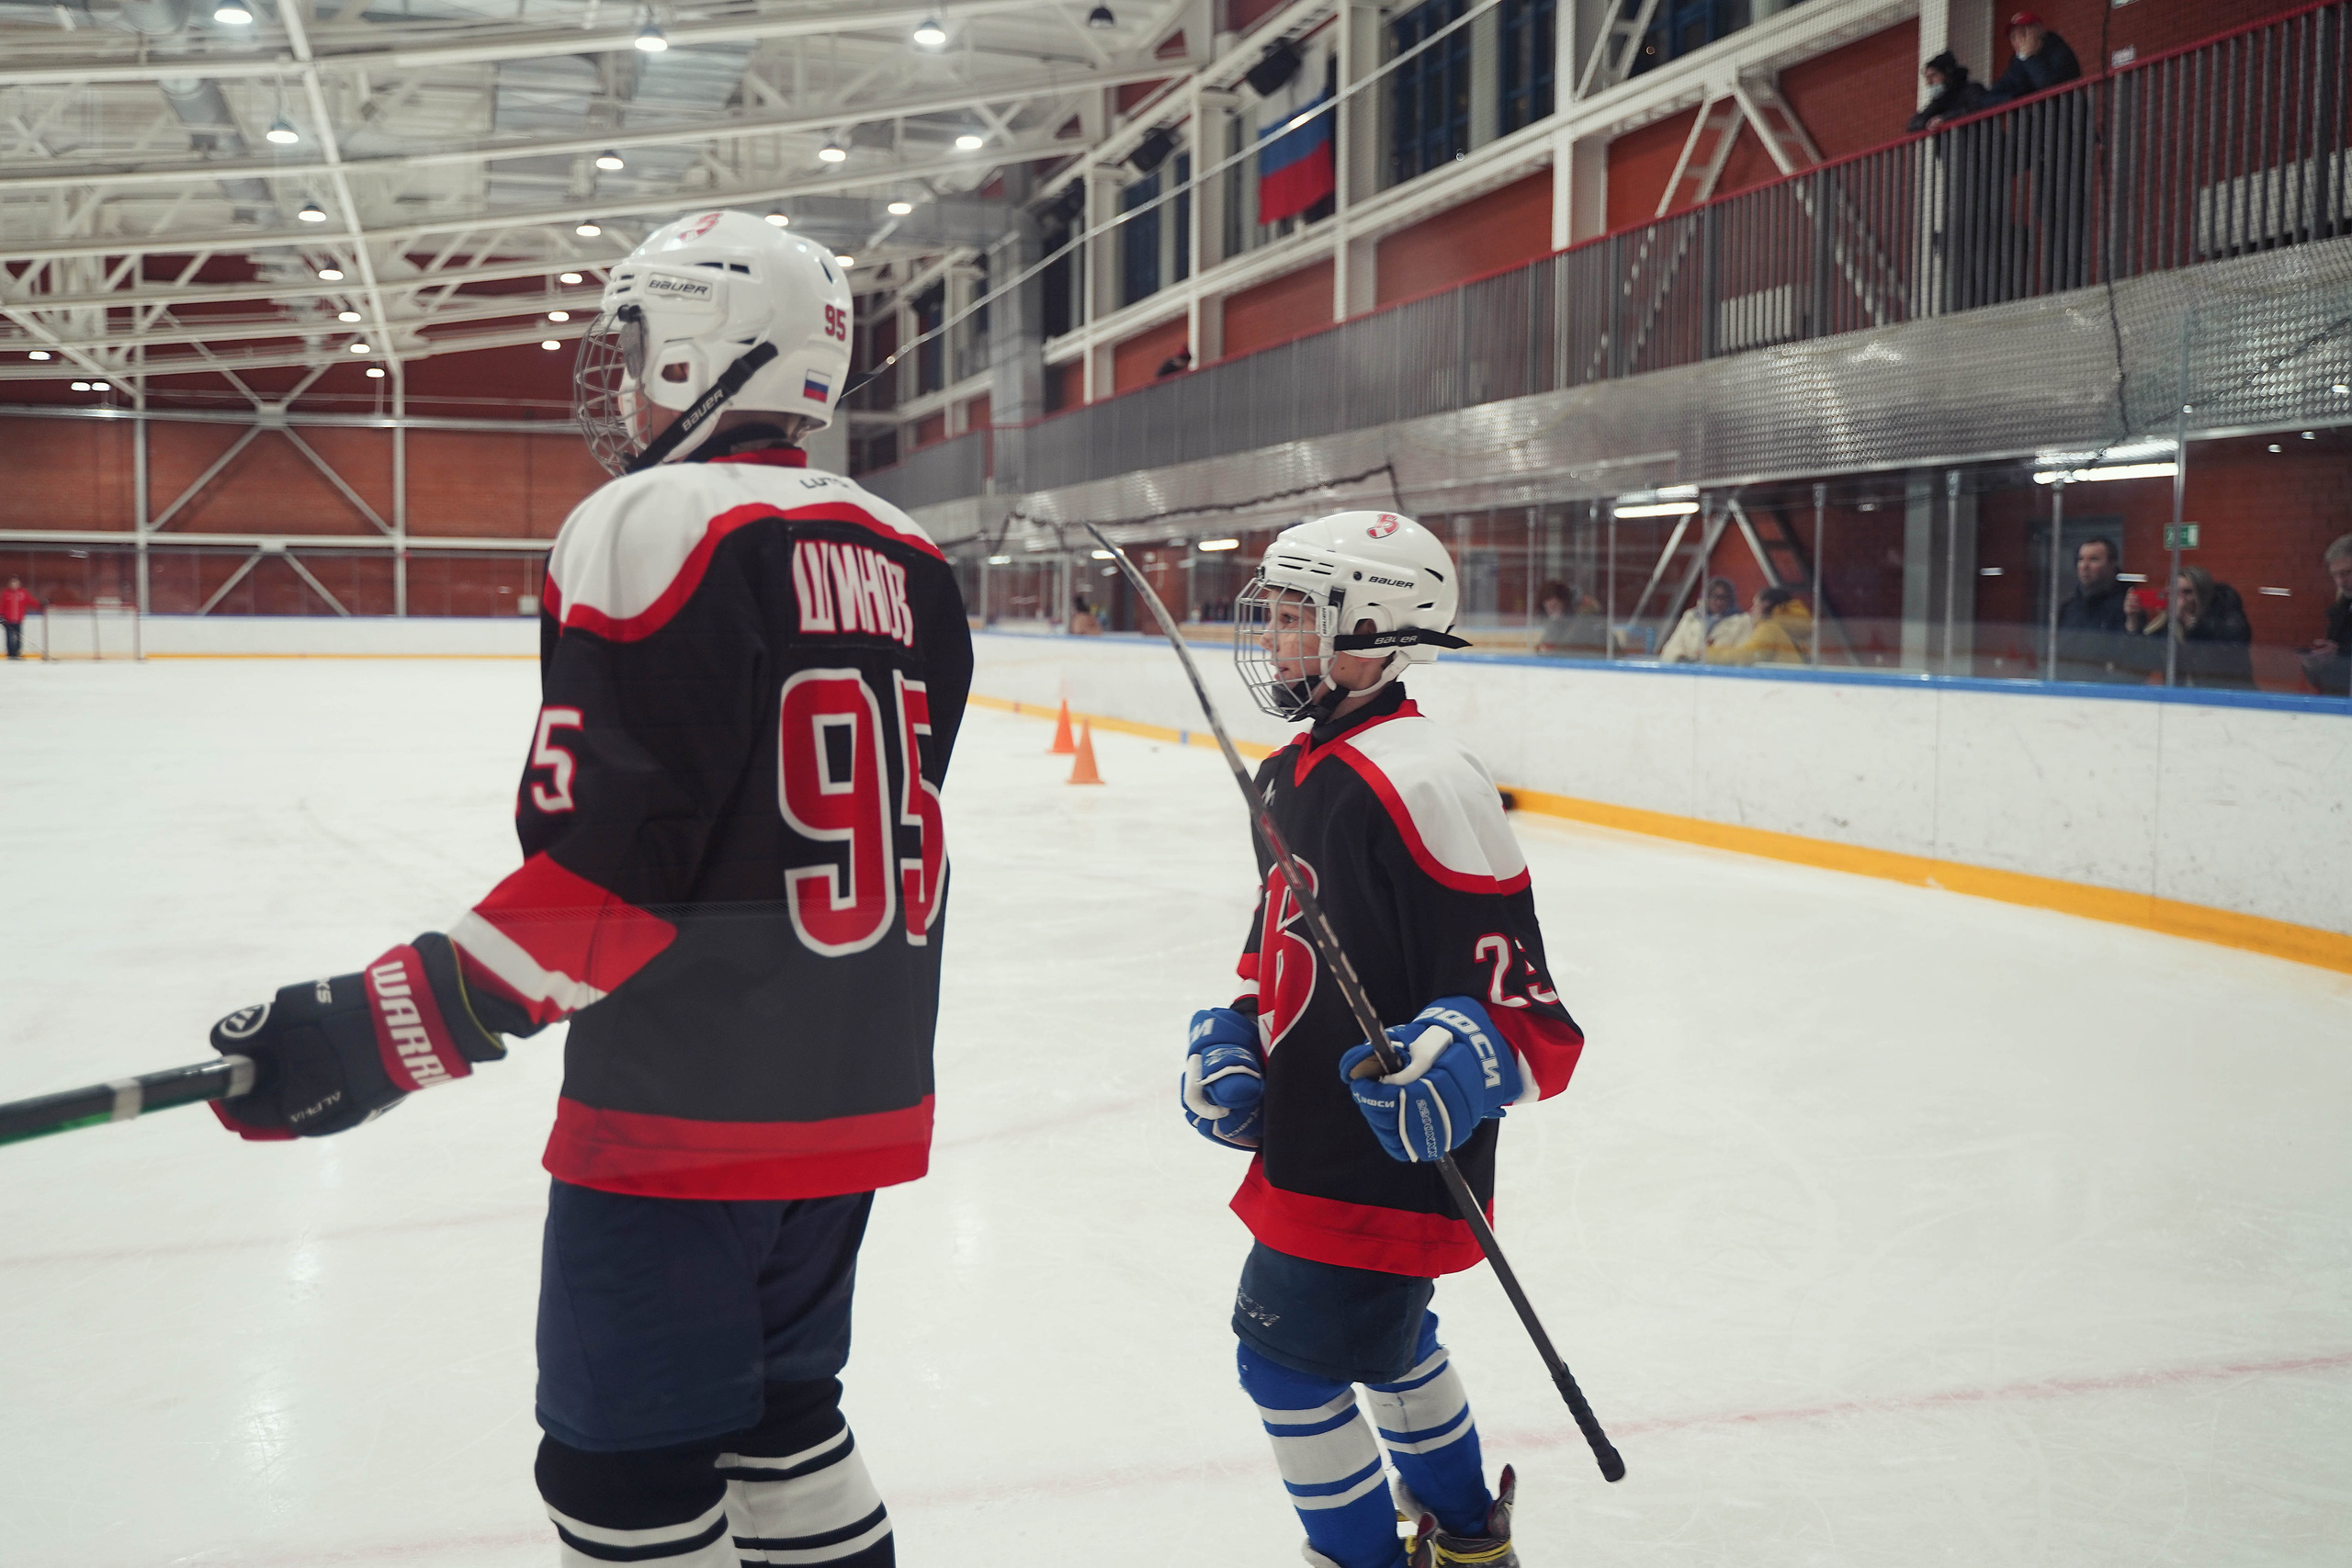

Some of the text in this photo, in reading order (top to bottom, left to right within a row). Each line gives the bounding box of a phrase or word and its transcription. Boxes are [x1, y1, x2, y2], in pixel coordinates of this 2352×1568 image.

[647, 279, 709, 296] BAUER
[824, 304, 847, 342] 95
[1368, 575, 1415, 590] BAUER
[778, 667, 947, 958] 95
[370, 960, 455, 1090] WARRI
